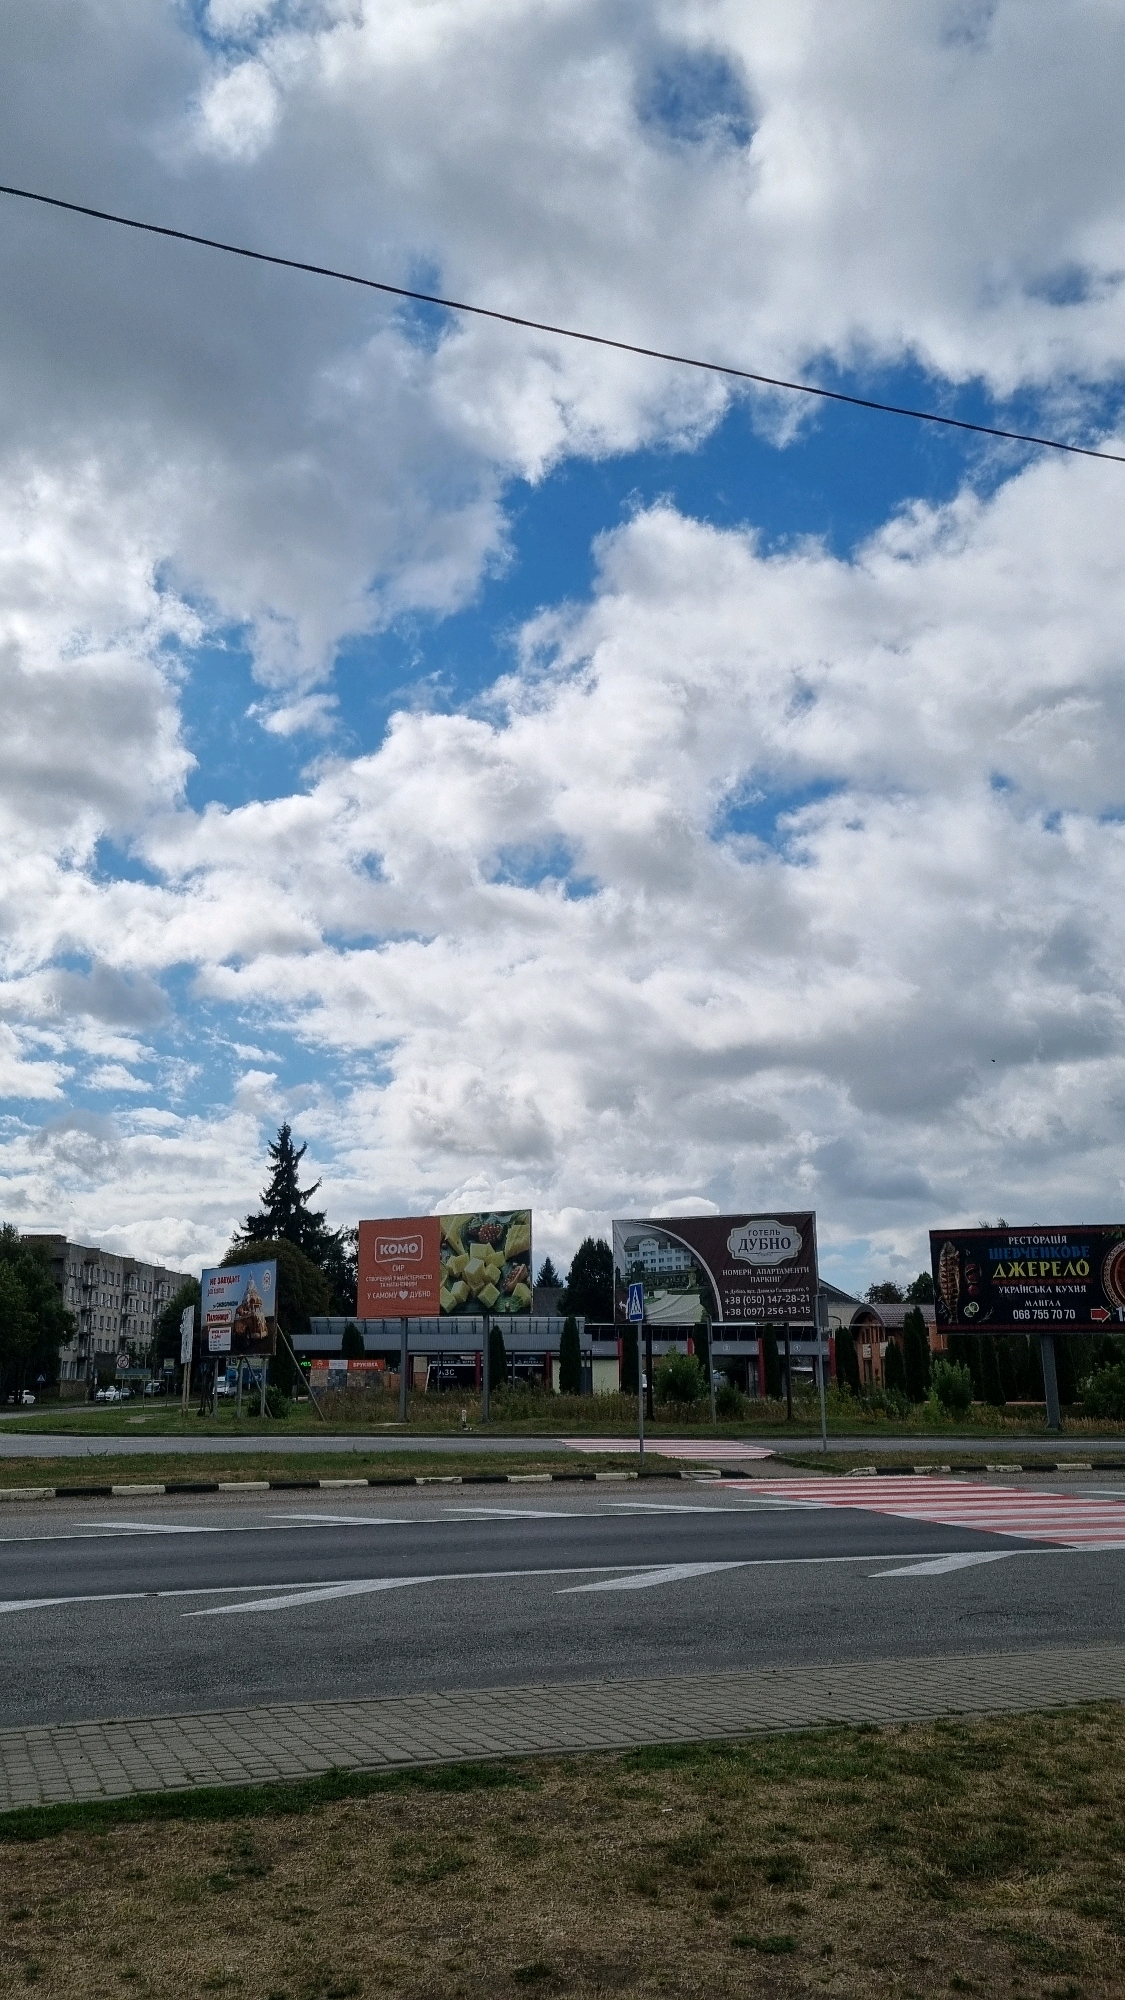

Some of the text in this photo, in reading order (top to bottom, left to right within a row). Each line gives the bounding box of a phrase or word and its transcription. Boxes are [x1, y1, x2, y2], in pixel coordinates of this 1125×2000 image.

[1008, 1234, 1067, 1244] РЕСТОРАЦІЯ
[380, 1243, 418, 1254] КОМО
[738, 1237, 792, 1253] ДУБНО
[988, 1245, 1090, 1260] ШЕВЧЕНКОВЕ
[722, 1268, 752, 1276] НОМЕРИ
[992, 1259, 1090, 1279] ДЖЕРЕЛО
[410, 1290, 431, 1299] ДУБНО
[998, 1284, 1087, 1294] УКРАЇНСЬКА КУХНЯ
[724, 1294, 810, 1306] +38 (050) 147-28-21
[1024, 1299, 1061, 1307] МАНГАЛ
[724, 1306, 811, 1317] +38 (097) 256-13-15
[1013, 1308, 1076, 1320] 068 755 70 70
